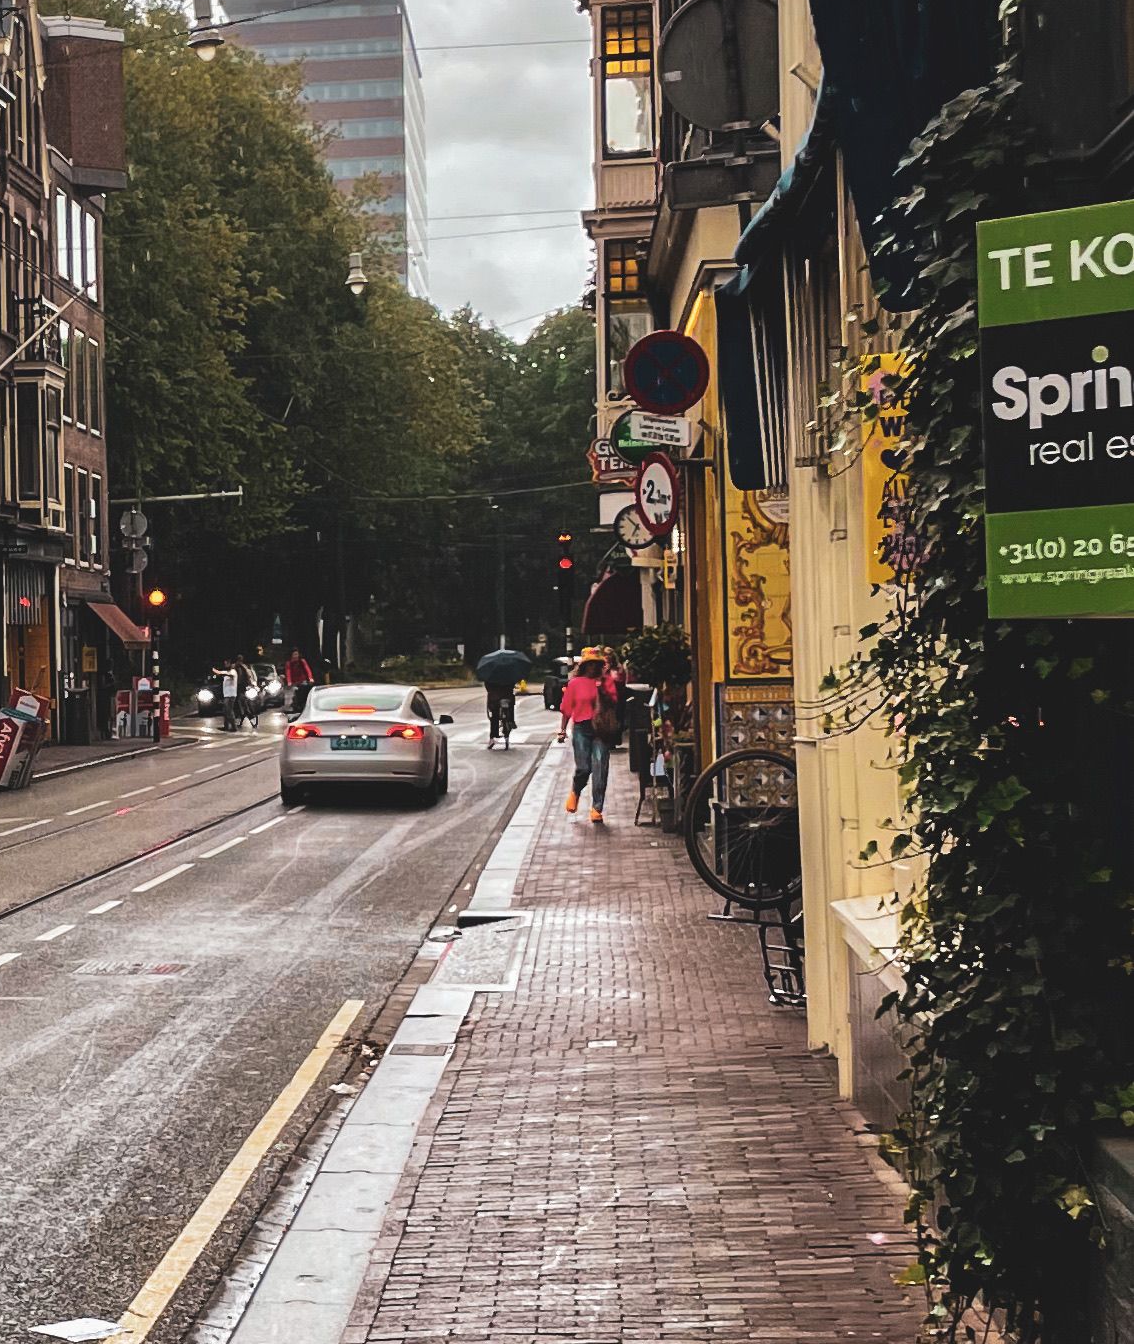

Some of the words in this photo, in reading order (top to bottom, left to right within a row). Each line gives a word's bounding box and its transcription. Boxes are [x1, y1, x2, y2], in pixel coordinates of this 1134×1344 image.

[987, 243, 1055, 290] TE
[992, 345, 1134, 430] Sprin
[1029, 432, 1094, 466] real
[999, 536, 1066, 565] +31(0)
[1073, 538, 1103, 557] 20
